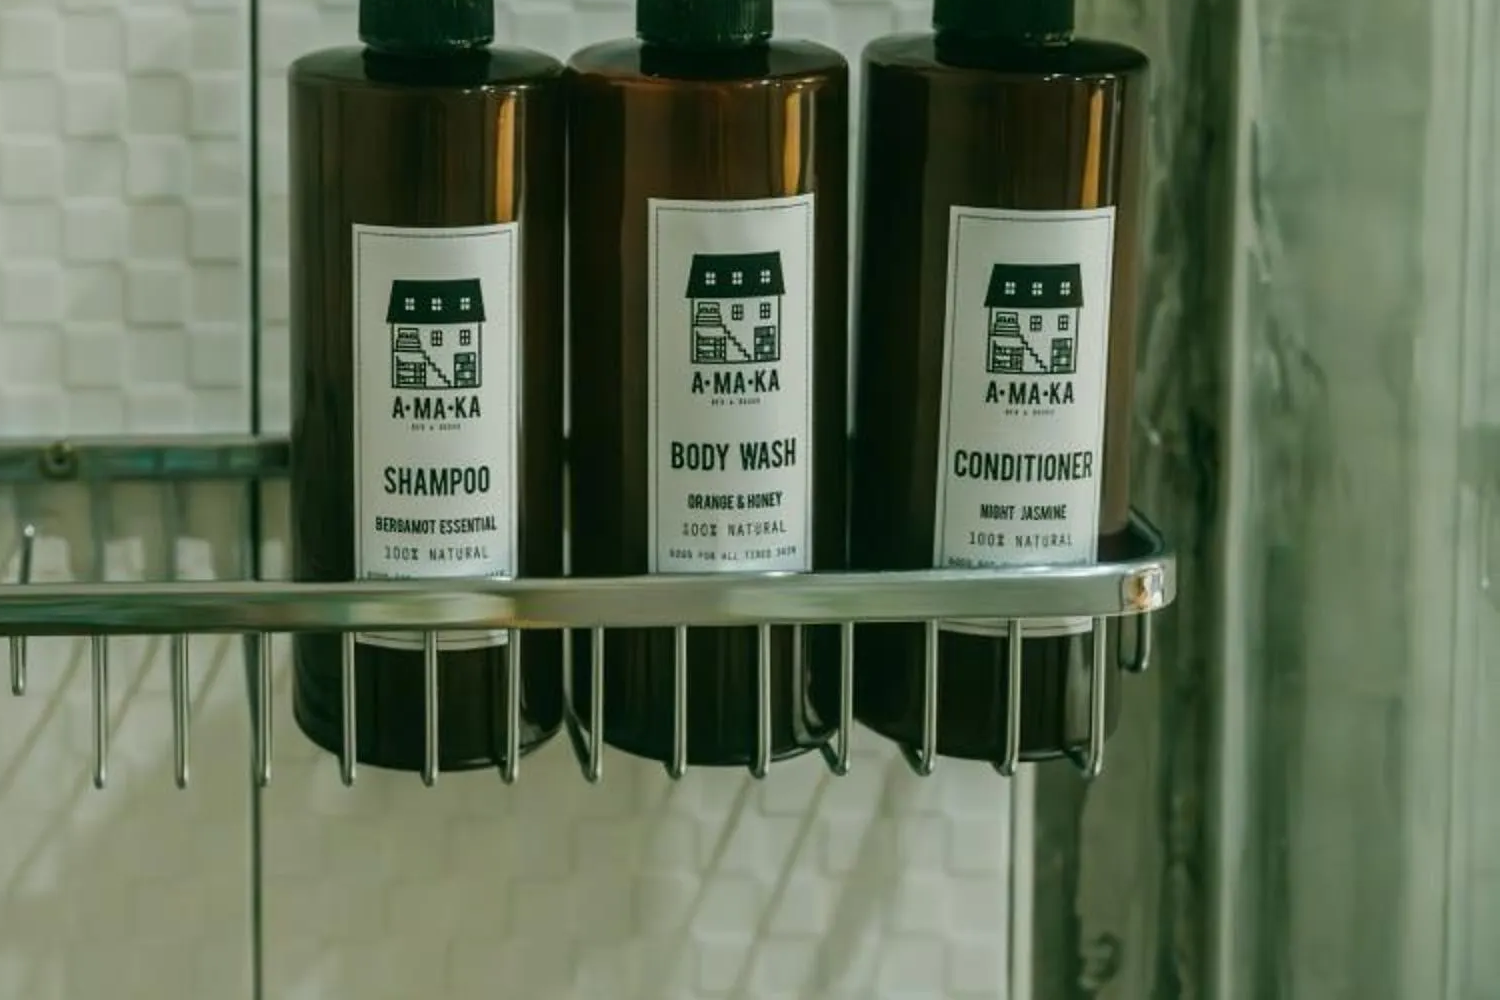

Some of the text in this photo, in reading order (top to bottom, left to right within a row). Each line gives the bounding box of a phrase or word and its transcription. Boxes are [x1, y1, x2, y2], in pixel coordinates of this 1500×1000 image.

[671, 438, 796, 471] BODY WASH
[953, 449, 1093, 482] CONDITIONER
[384, 465, 490, 496] SHAMPOO
[687, 491, 783, 510] ORANGE & HONEY
[980, 503, 1067, 521] NIGHT JASMINE
[375, 515, 497, 535] BERGAMOT ESSENTIAL
[683, 520, 787, 537] 100% NATURAL
[969, 531, 1073, 549] 100% NATURAL
[384, 544, 489, 561] 100% NATURAL
